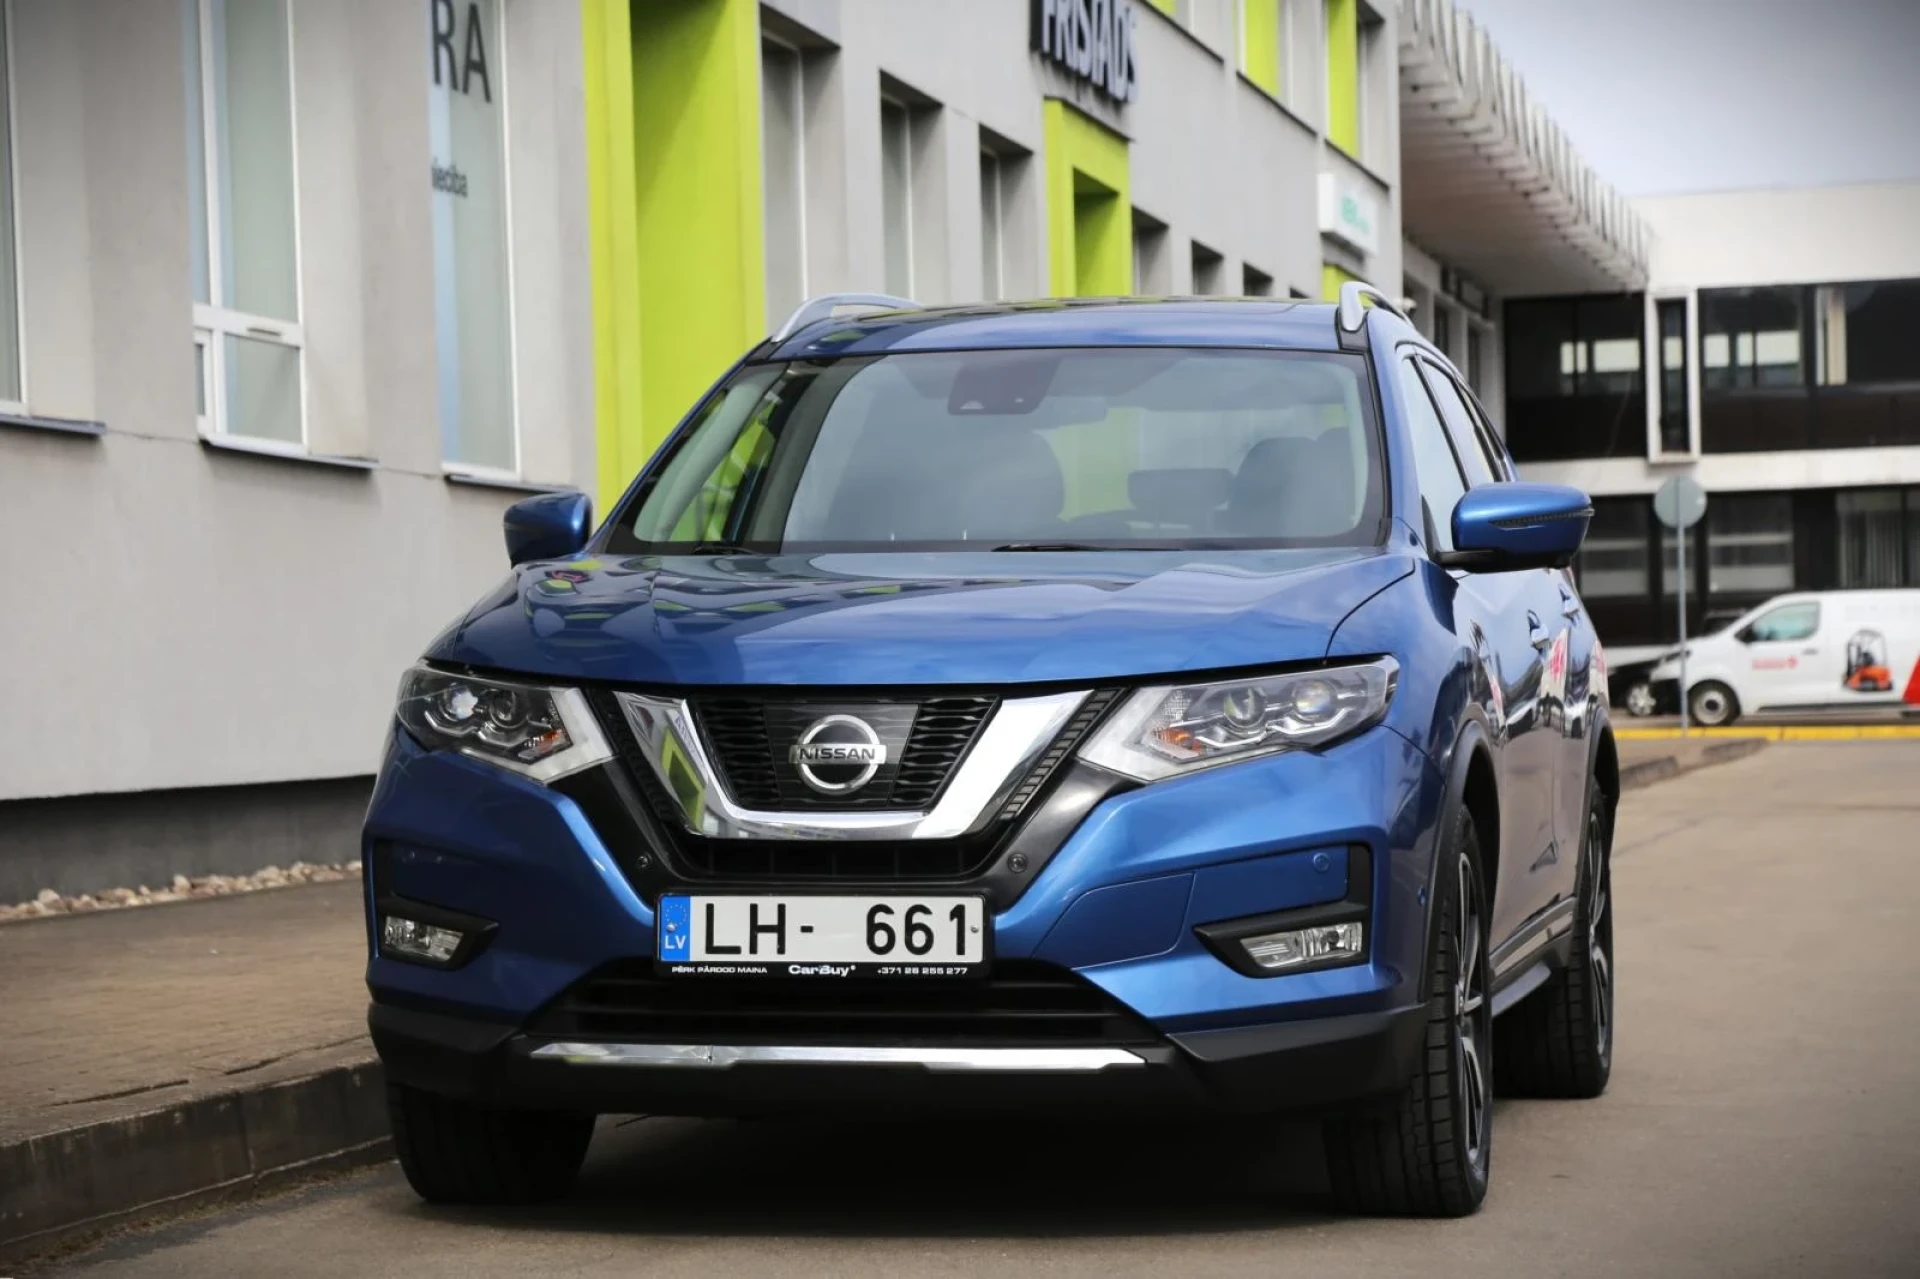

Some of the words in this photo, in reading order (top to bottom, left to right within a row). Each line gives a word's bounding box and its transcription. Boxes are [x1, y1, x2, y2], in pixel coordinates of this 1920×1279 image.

[799, 748, 876, 760] NISSAN
[866, 903, 966, 956] 661
[664, 935, 686, 949] LV
[737, 966, 768, 974] MAINA
[946, 966, 968, 975] 277
